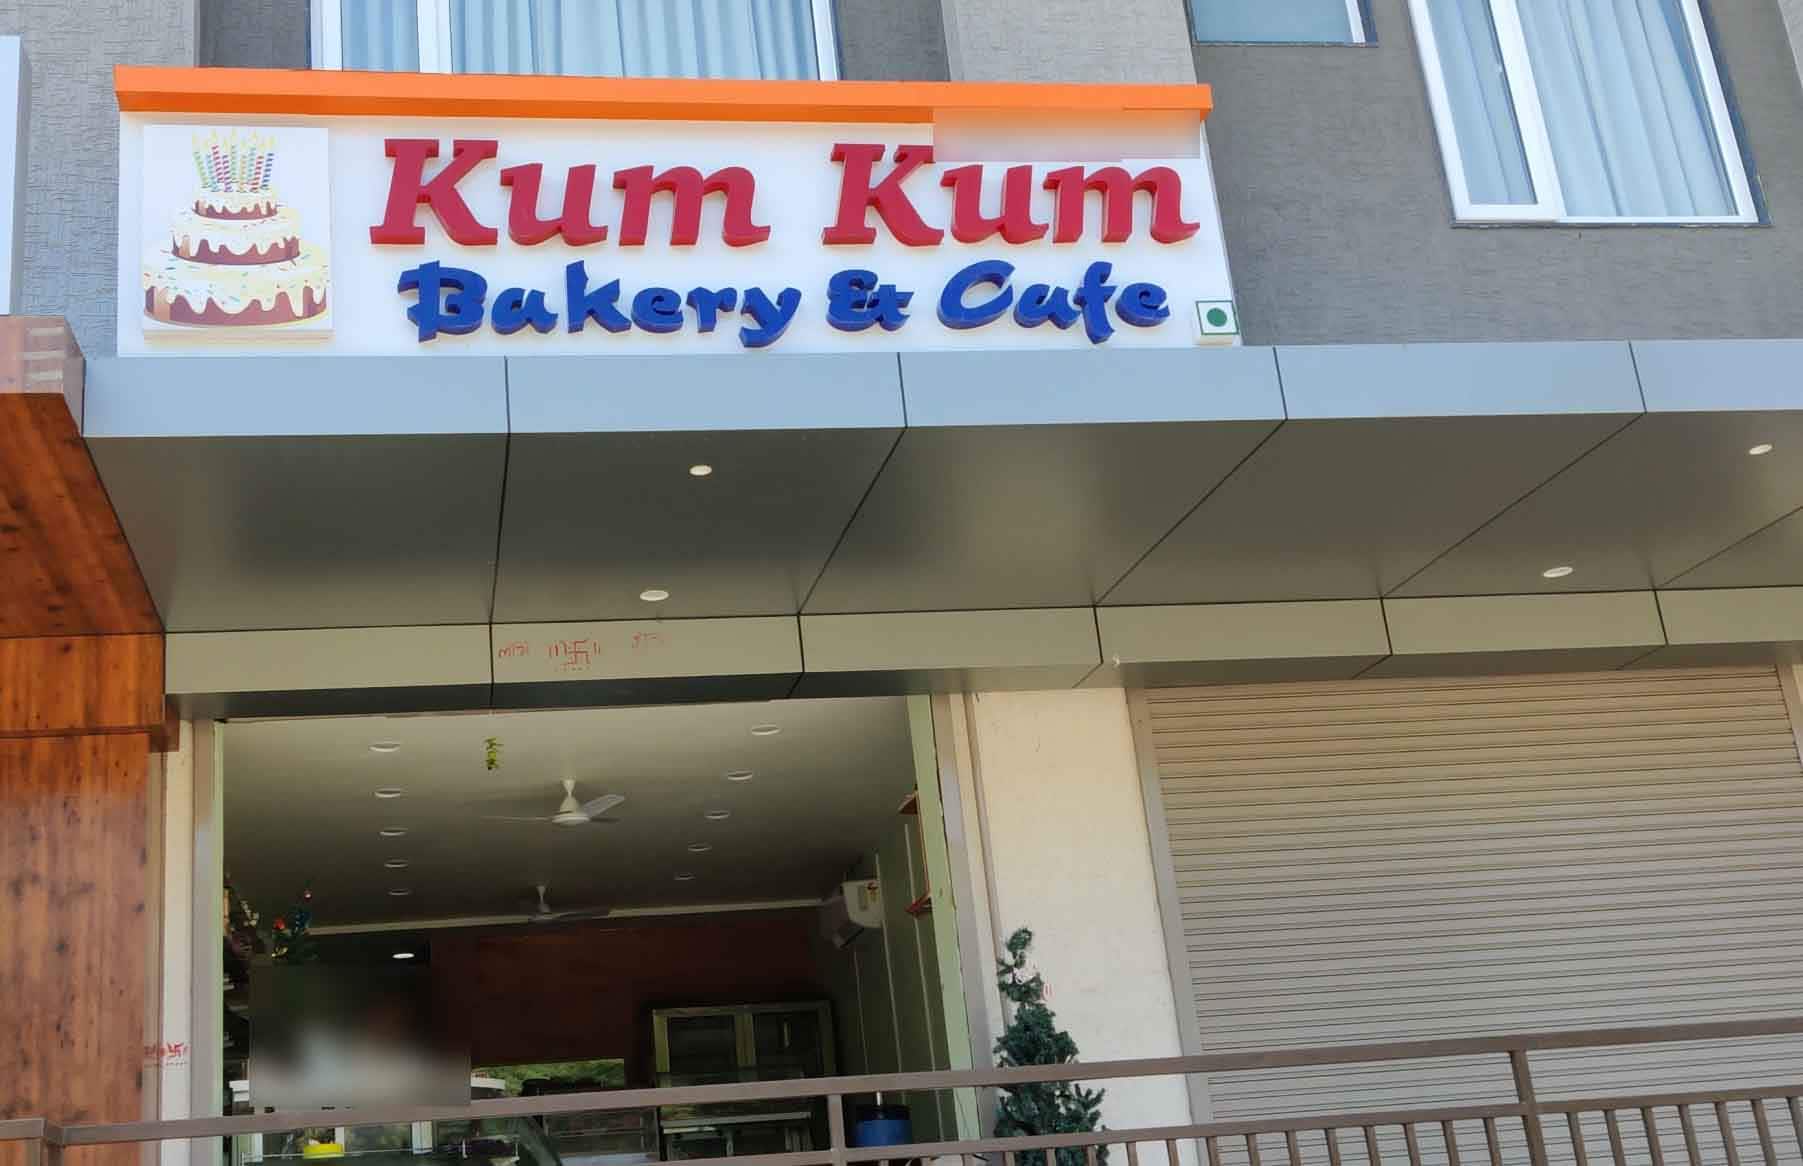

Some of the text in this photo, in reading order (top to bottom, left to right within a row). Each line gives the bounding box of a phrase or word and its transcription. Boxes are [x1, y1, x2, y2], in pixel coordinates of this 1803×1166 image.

[370, 138, 1200, 247] Kum Kum
[398, 259, 1170, 348] Bakery & Cafe
